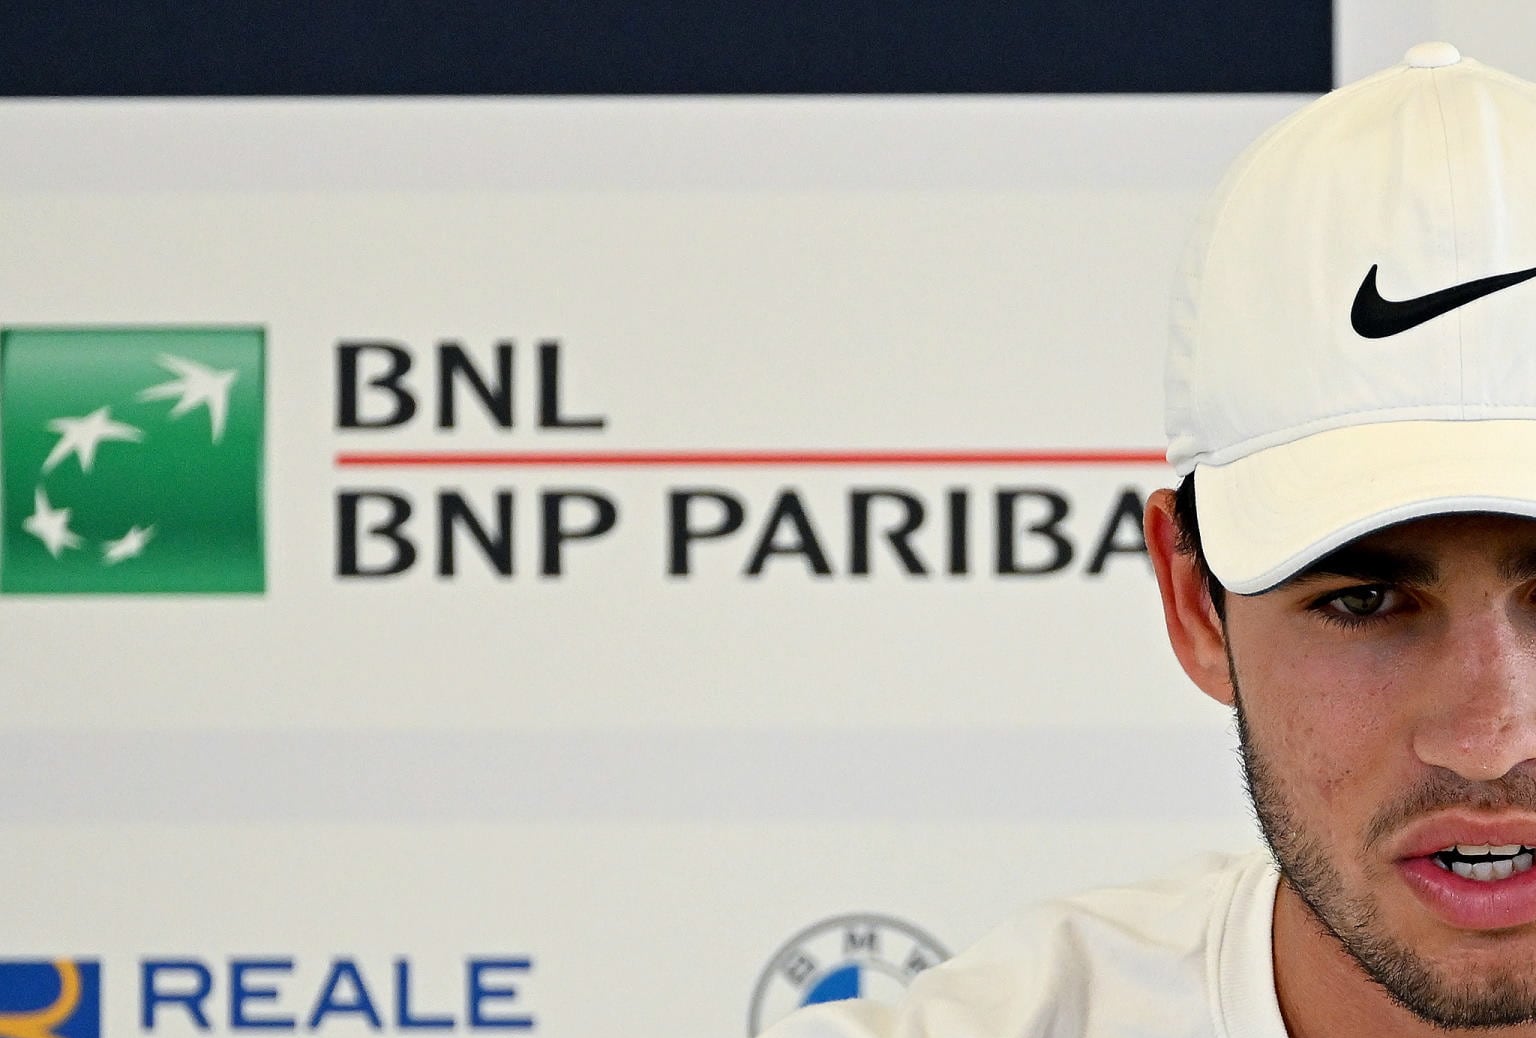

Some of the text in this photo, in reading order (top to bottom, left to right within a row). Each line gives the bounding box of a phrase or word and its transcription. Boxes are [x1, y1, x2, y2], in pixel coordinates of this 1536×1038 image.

[335, 339, 607, 430] BNL
[335, 486, 1148, 578] BNP PARIBA
[141, 958, 534, 1030] REALE
